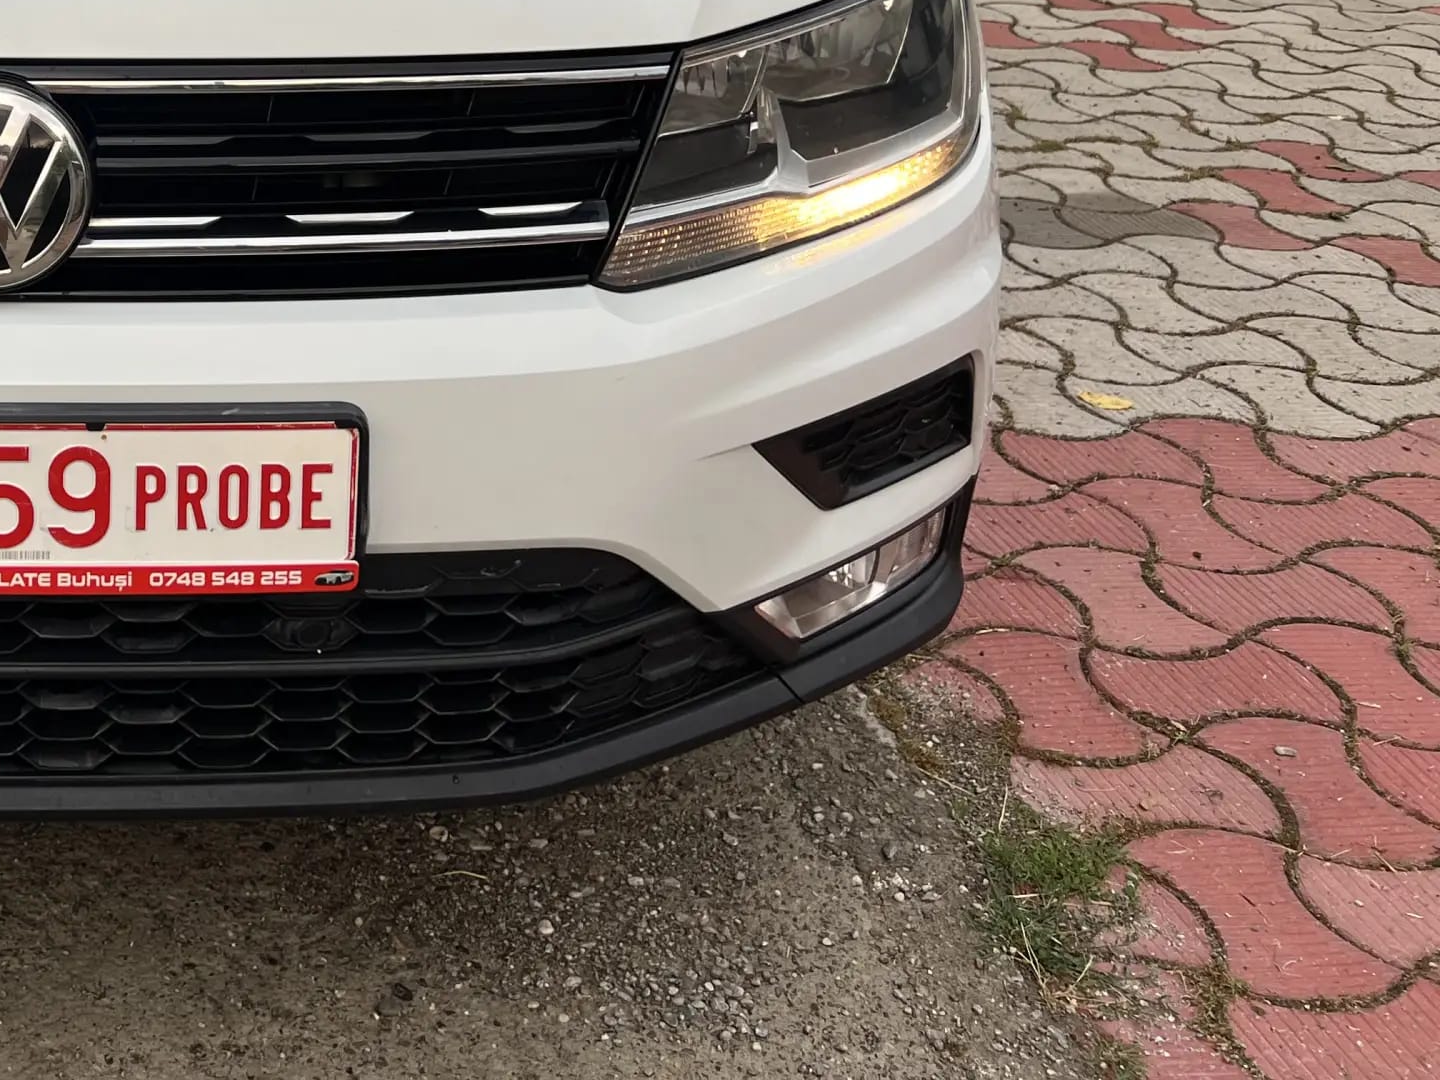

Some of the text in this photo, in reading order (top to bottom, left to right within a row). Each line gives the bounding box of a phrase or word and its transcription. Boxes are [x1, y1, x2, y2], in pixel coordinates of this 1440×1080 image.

[134, 462, 334, 531] PROBE
[148, 571, 206, 587] 0748
[211, 571, 255, 587] 548
[259, 570, 303, 586] 255
